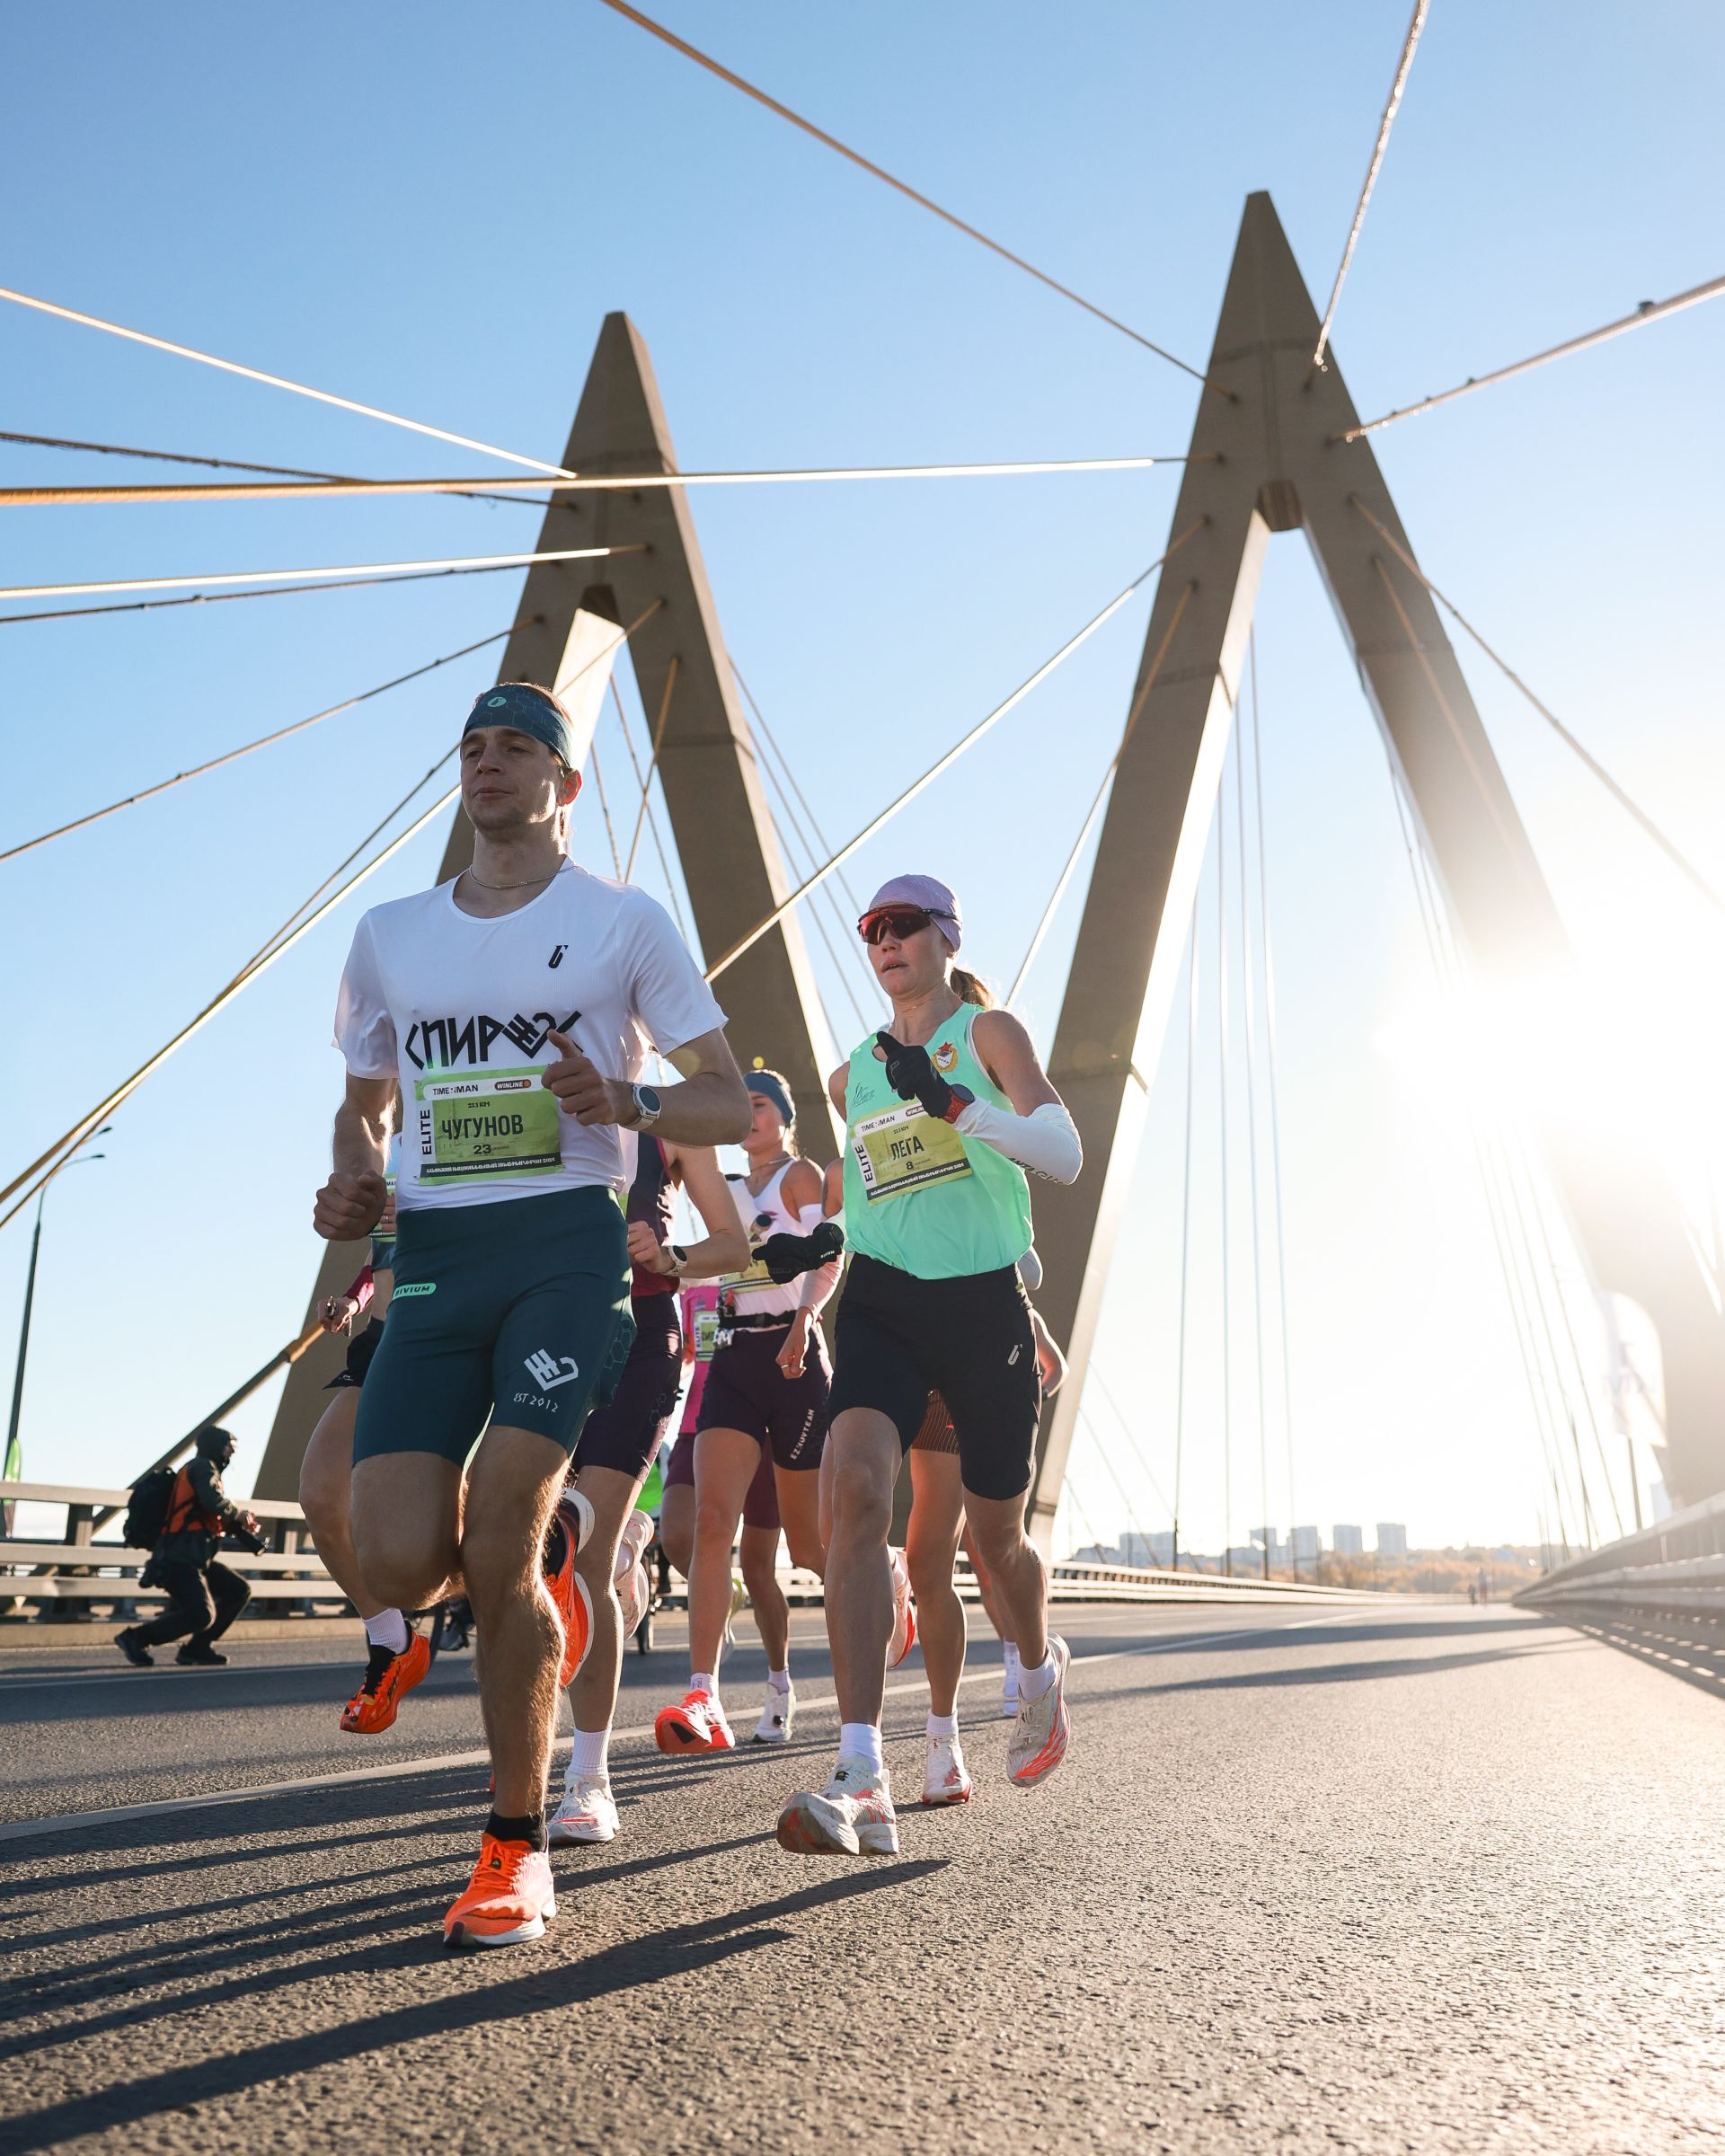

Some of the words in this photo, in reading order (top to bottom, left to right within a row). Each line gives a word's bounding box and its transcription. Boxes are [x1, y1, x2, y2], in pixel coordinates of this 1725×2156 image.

[497, 1081, 525, 1090] WINLINE
[420, 1109, 432, 1155] ELITE
[441, 1114, 524, 1140] ЧУГУНОВ
[473, 1144, 492, 1155] 23
[889, 1135, 924, 1161] ЛЕГА
[854, 1144, 873, 1182] ELITE
[905, 1161, 914, 1171] 8
[513, 1392, 529, 1403] EST
[529, 1395, 559, 1413] 2012
